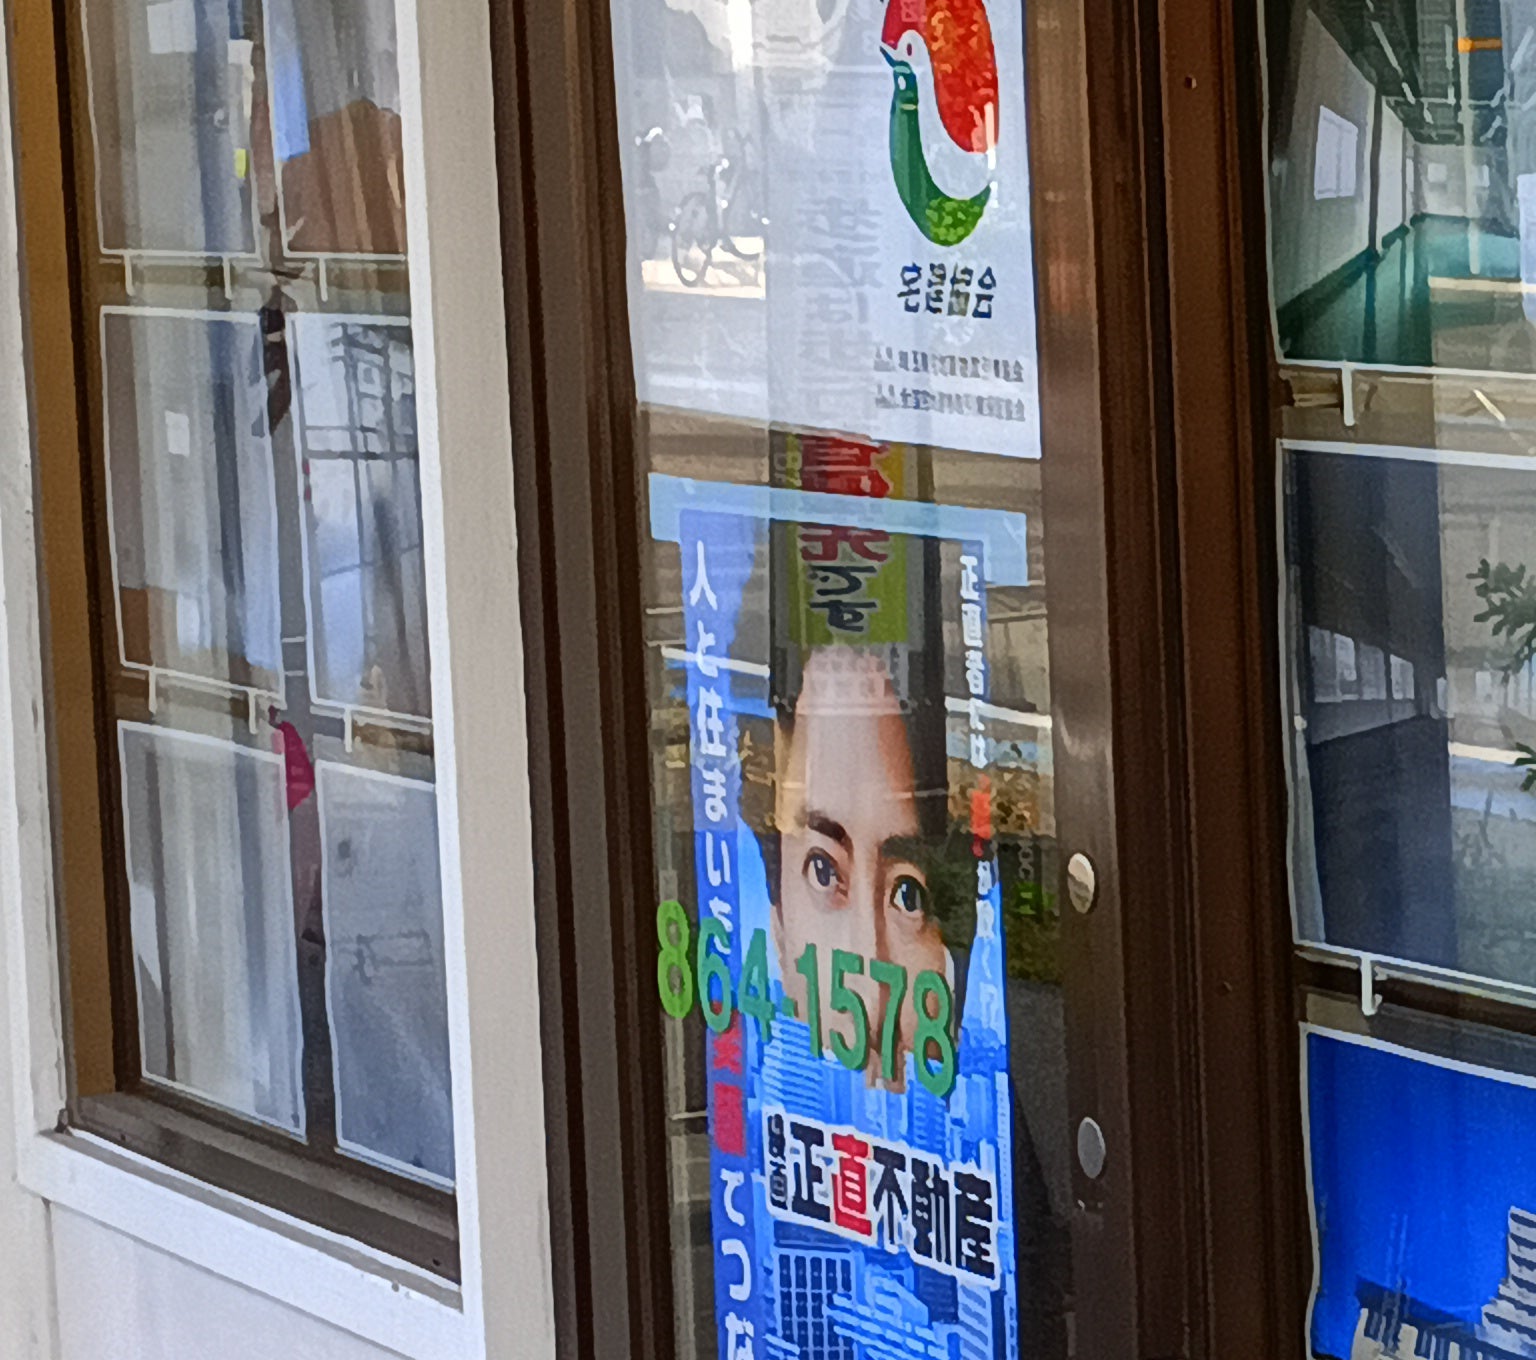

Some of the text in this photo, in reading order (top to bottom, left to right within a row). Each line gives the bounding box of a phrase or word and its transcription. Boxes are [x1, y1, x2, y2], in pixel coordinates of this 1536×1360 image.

[789, 1120, 996, 1281] 正直不動産
